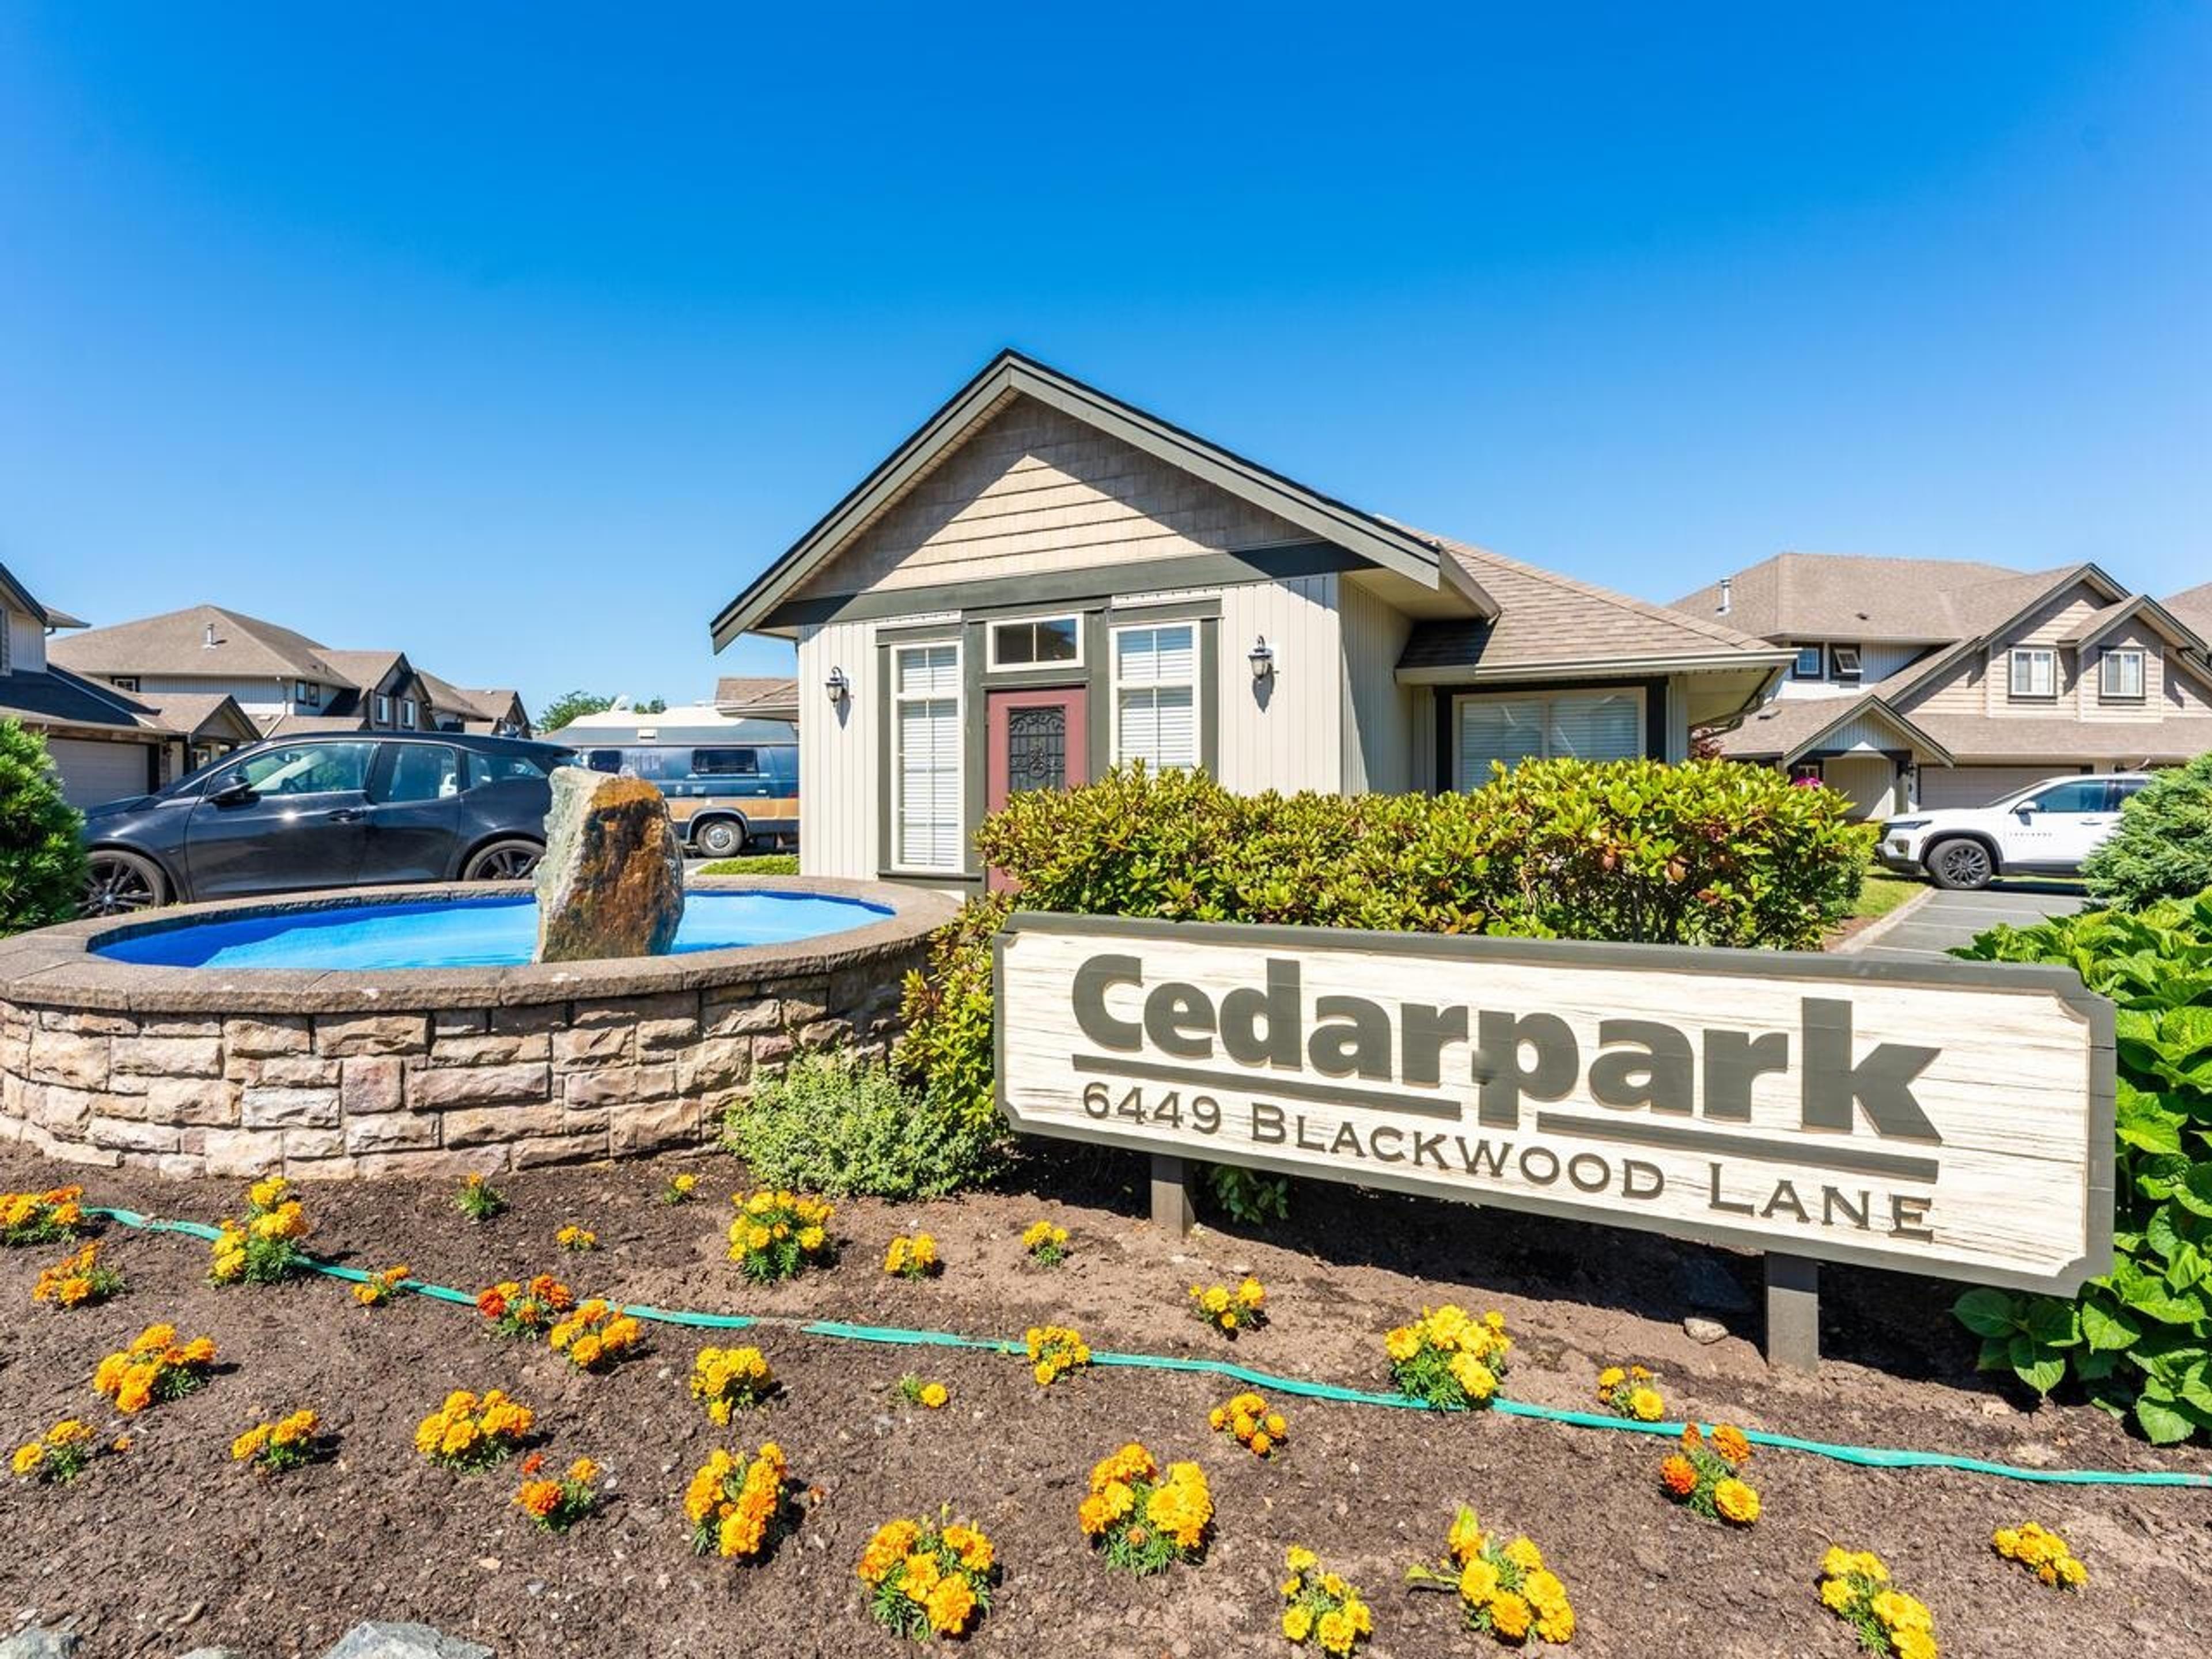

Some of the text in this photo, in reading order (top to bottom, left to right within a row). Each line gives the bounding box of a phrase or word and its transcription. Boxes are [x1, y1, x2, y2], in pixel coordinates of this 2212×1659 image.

[1071, 953, 1943, 1146] Cedarpark
[1082, 1082, 1934, 1243] 6449 BLACKWOOD LANE
